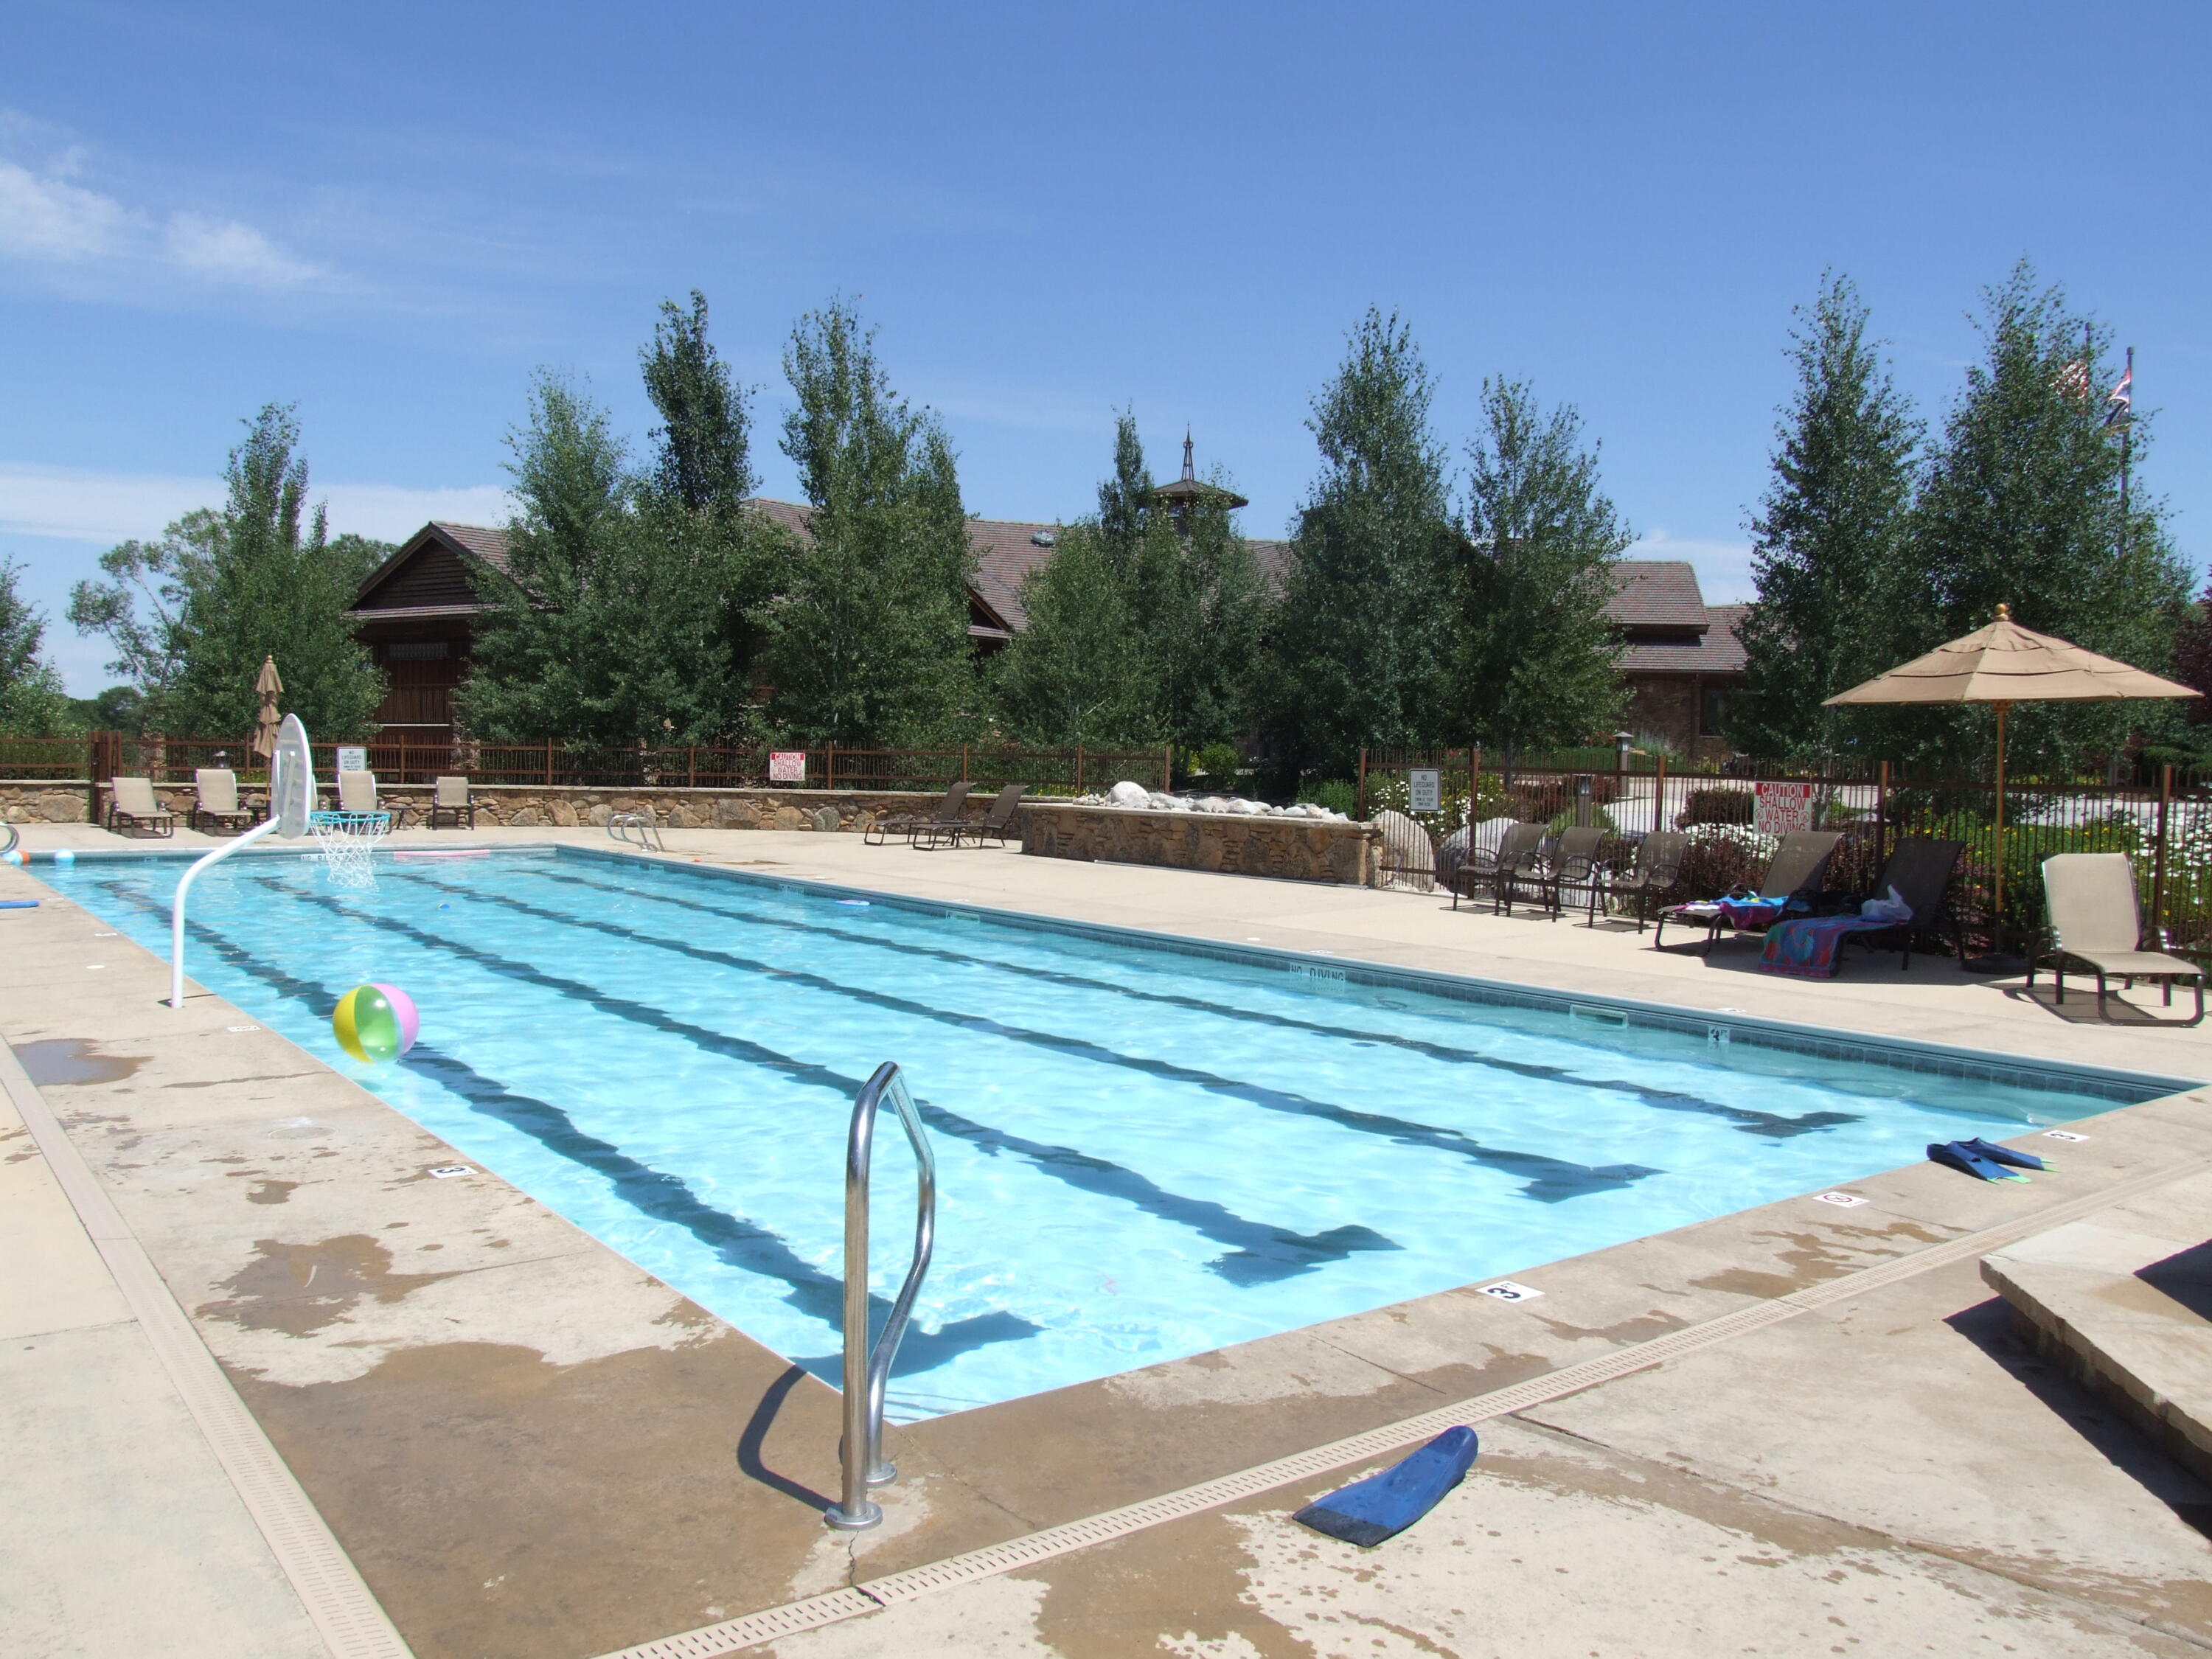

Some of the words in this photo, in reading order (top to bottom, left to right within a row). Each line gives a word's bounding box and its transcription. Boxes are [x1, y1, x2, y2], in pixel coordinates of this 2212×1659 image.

[1761, 783, 1804, 798] CAUTION
[1759, 796, 1806, 810] SHALLOW
[1765, 810, 1799, 822] WATER
[1758, 820, 1771, 833] NO
[1774, 821, 1806, 834] DIVING
[1290, 964, 1302, 974] NO
[1310, 967, 1345, 981] DIVING
[1486, 1287, 1522, 1299] 3
